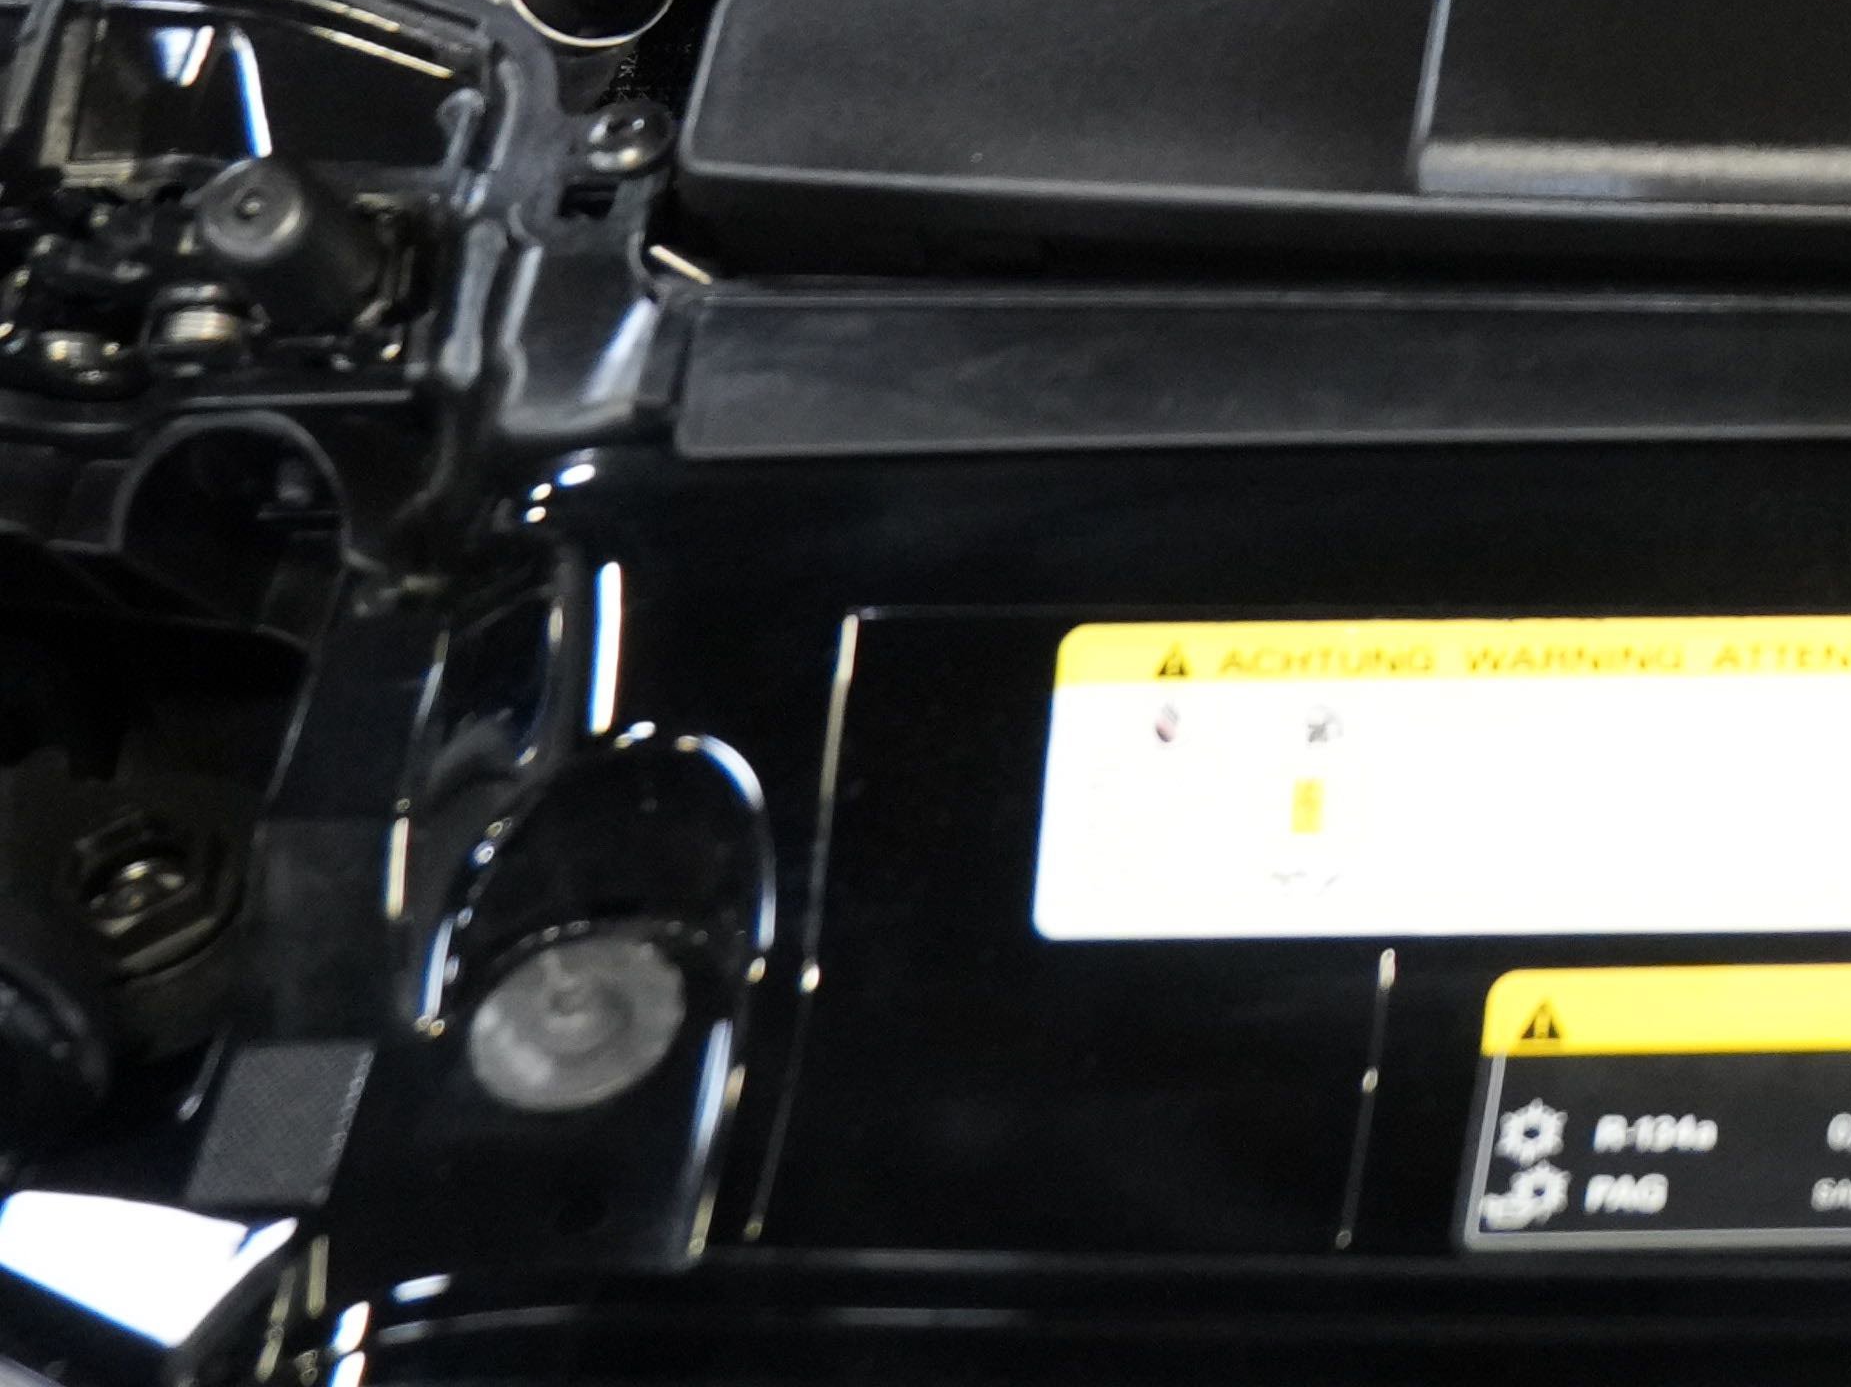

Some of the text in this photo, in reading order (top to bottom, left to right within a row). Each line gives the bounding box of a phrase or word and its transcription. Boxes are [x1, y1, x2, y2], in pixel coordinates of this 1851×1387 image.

[1217, 645, 1435, 675] ACHTUNG
[1465, 643, 1682, 673] WARNING
[1584, 1173, 1668, 1214] PAG
